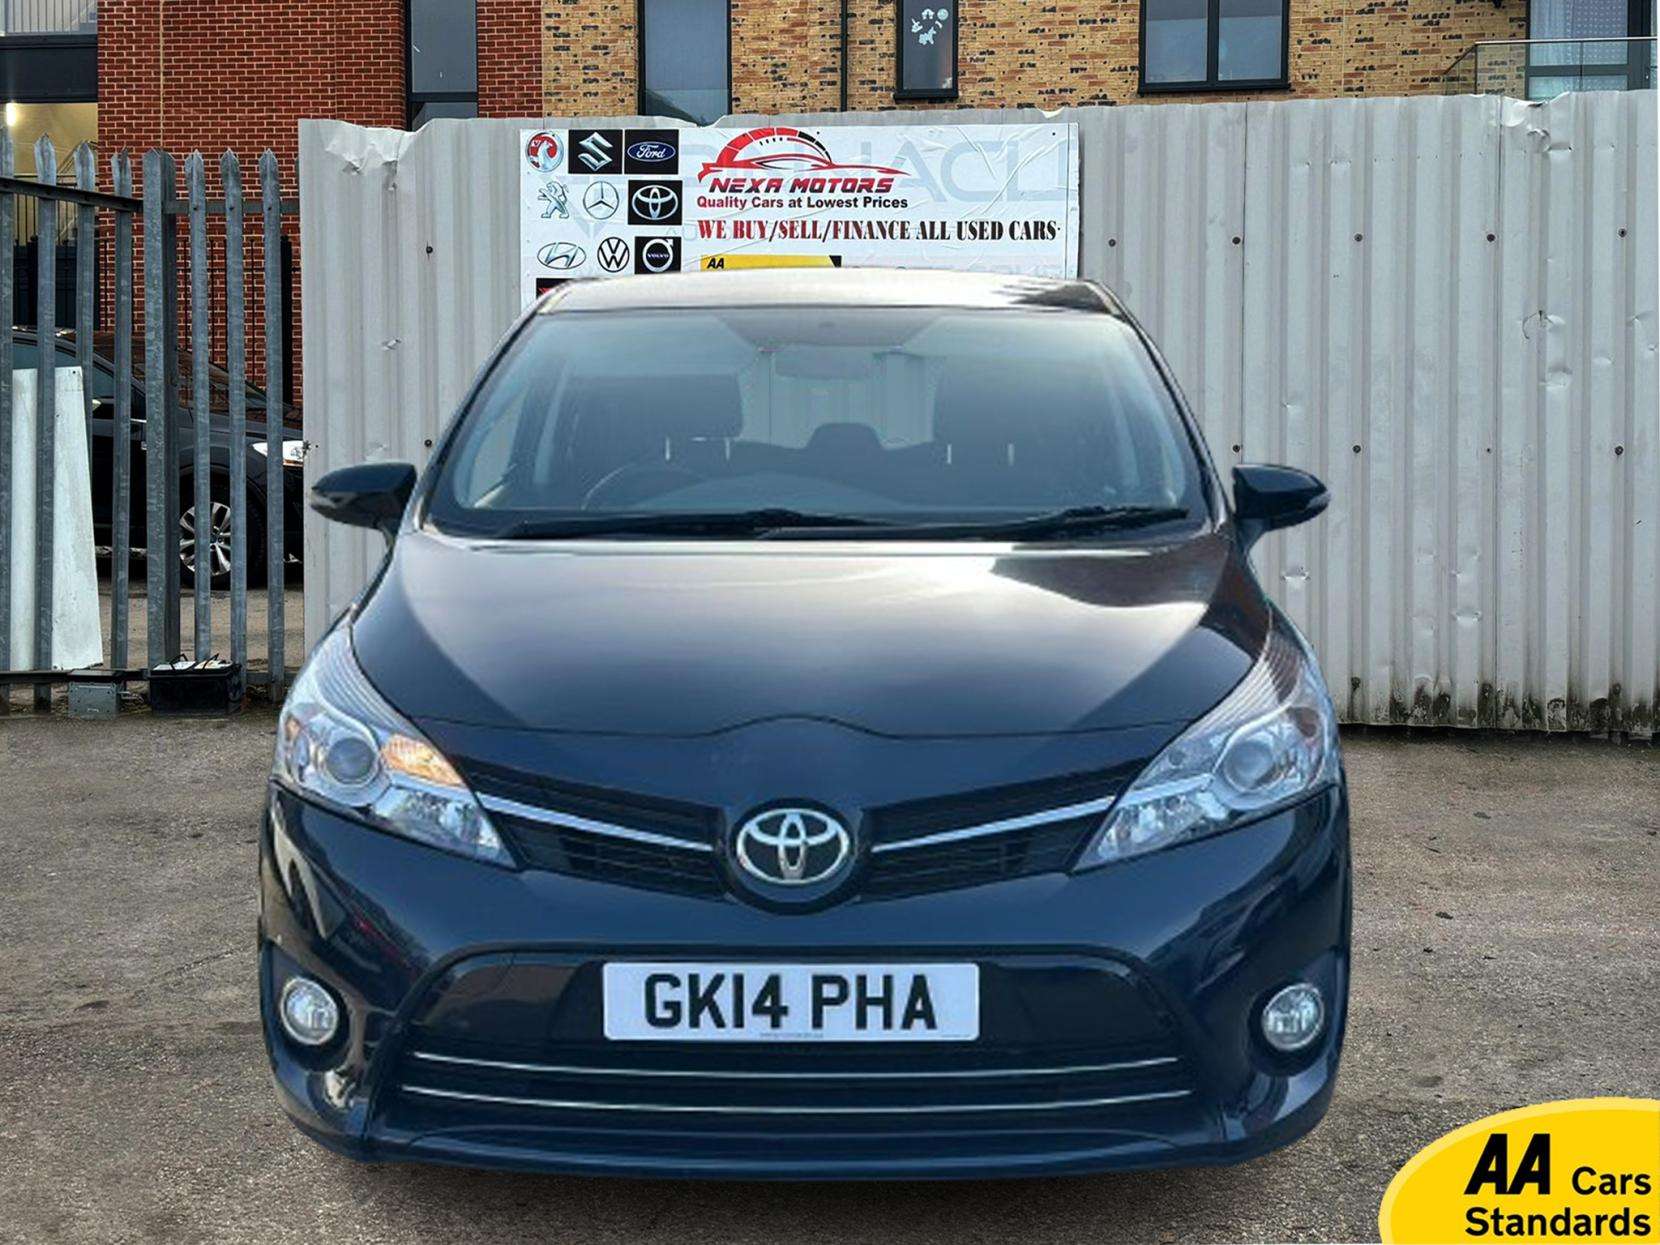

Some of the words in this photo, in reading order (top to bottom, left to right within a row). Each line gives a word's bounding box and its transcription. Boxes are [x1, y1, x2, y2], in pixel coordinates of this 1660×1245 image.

[636, 144, 666, 158] Ford
[709, 178, 783, 193] NEXA
[789, 177, 894, 193] MOTORS
[697, 196, 746, 210] Quality
[752, 196, 784, 208] Cars
[788, 196, 803, 208] at
[807, 196, 859, 208] Lowest
[863, 196, 908, 208] Prices
[697, 220, 726, 240] WE
[733, 220, 911, 243] BUY/SELL/FINANCE
[916, 220, 950, 240] ALL
[957, 220, 1003, 240] USED
[1009, 220, 1057, 240] CARS
[707, 257, 725, 269] AA
[644, 972, 789, 1029] GK14
[811, 974, 938, 1030] PHA
